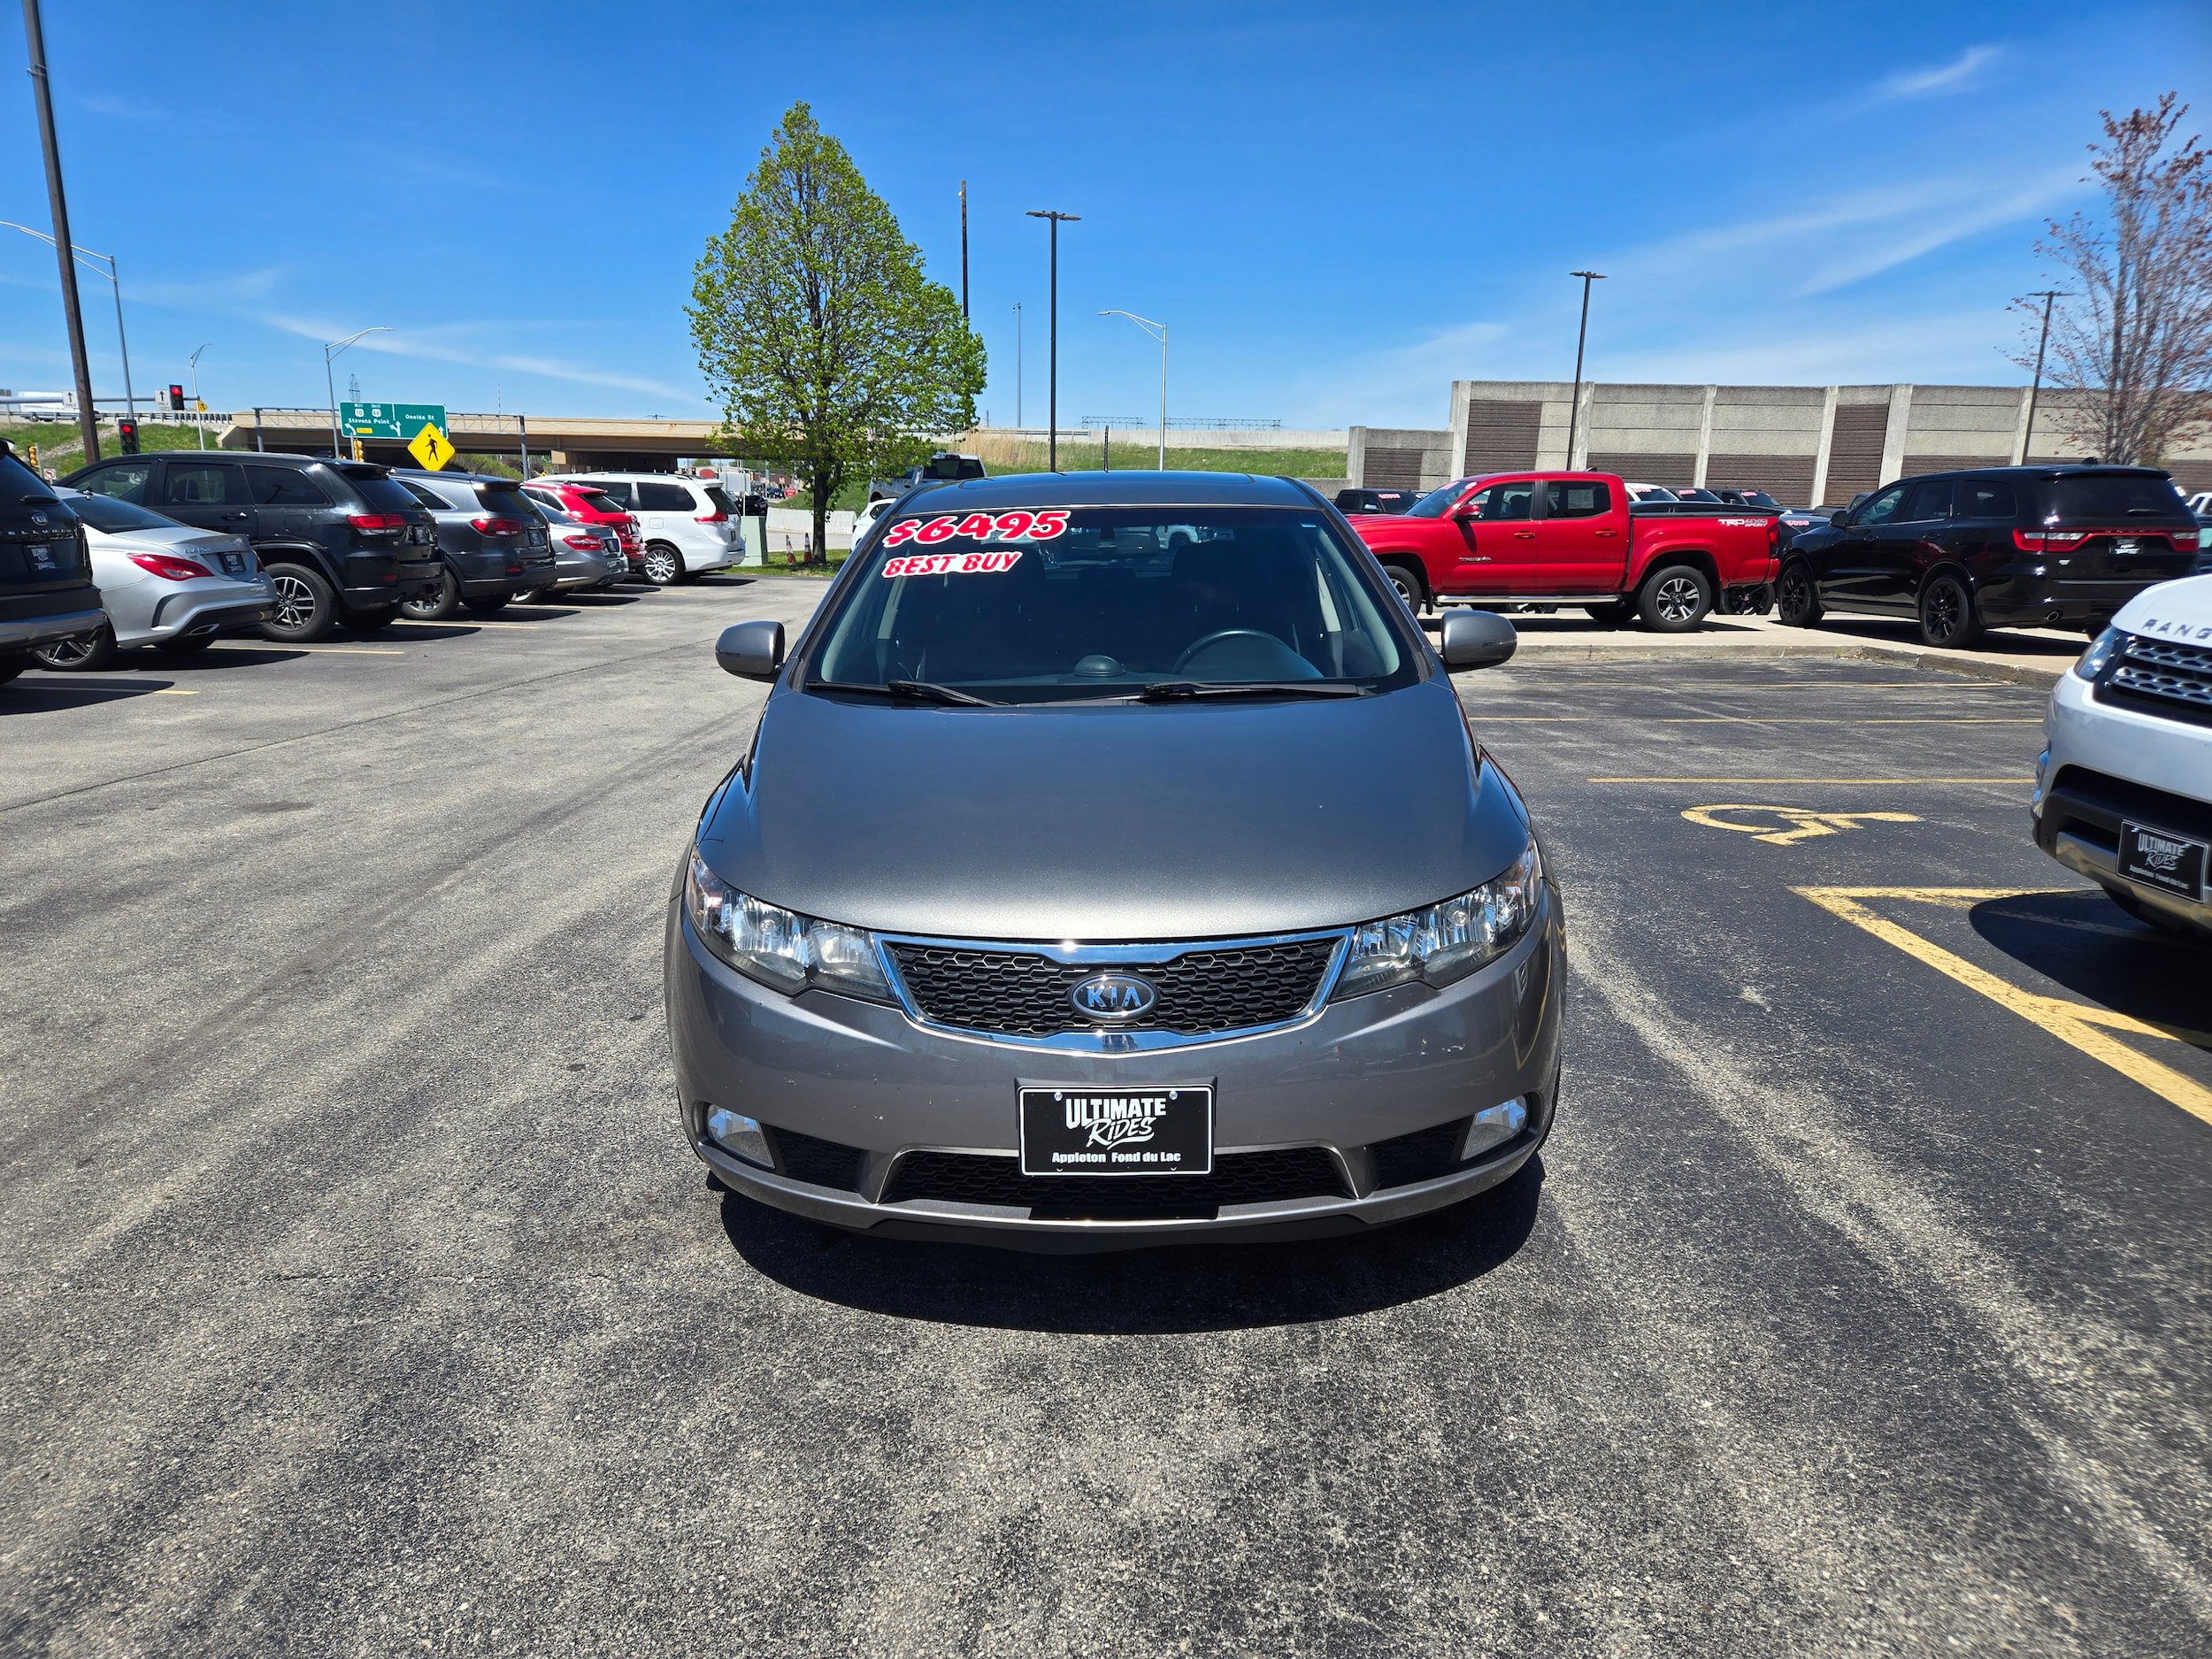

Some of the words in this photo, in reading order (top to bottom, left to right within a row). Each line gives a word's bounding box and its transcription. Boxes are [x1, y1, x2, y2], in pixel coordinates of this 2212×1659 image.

[883, 511, 1071, 547] $6495
[883, 554, 958, 577] BEST
[962, 551, 1022, 573] BUY
[2138, 833, 2185, 856] ULTIMATE
[1087, 985, 1141, 1007] KIA
[1065, 1098, 1166, 1129] ULTIMATE
[1052, 1152, 1106, 1164] Appleton
[1111, 1152, 1140, 1163] Fond
[1142, 1152, 1158, 1163] du
[1160, 1152, 1181, 1163] Lac
